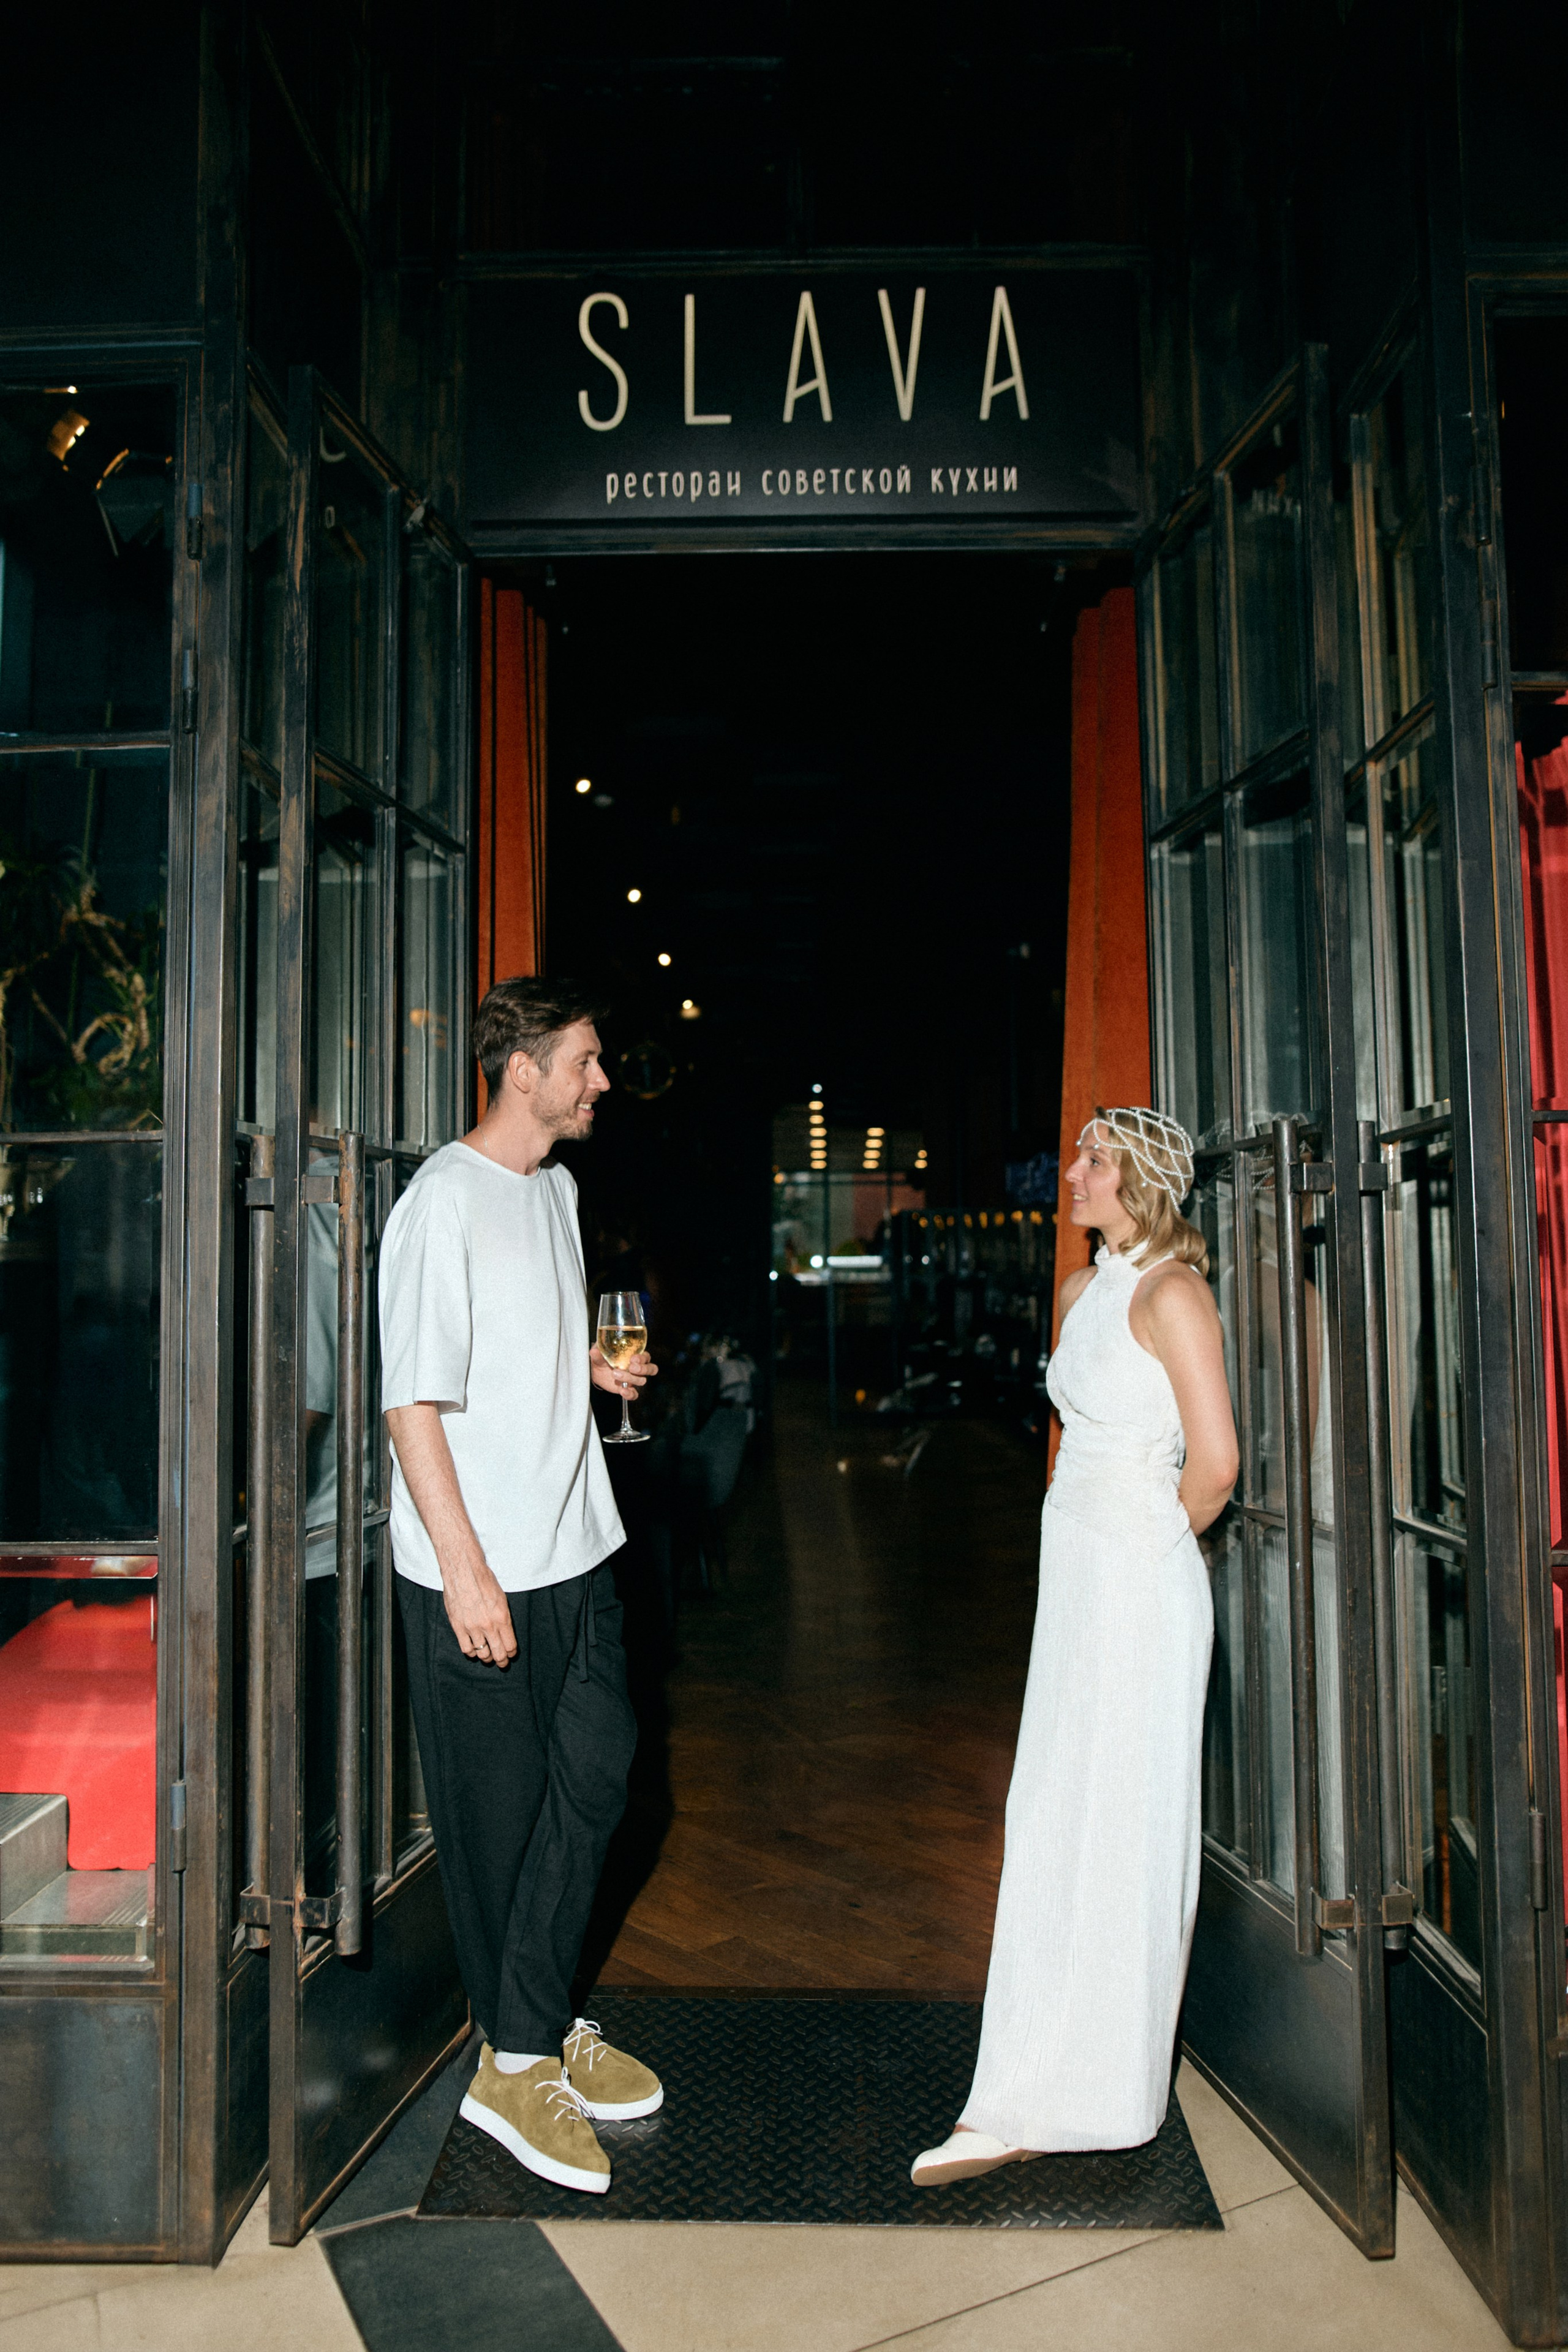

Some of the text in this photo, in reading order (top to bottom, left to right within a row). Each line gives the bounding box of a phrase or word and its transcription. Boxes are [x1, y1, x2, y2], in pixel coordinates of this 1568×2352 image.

[578, 286, 1029, 431] SLAVA
[606, 465, 1017, 504] ресторан советской кухни
